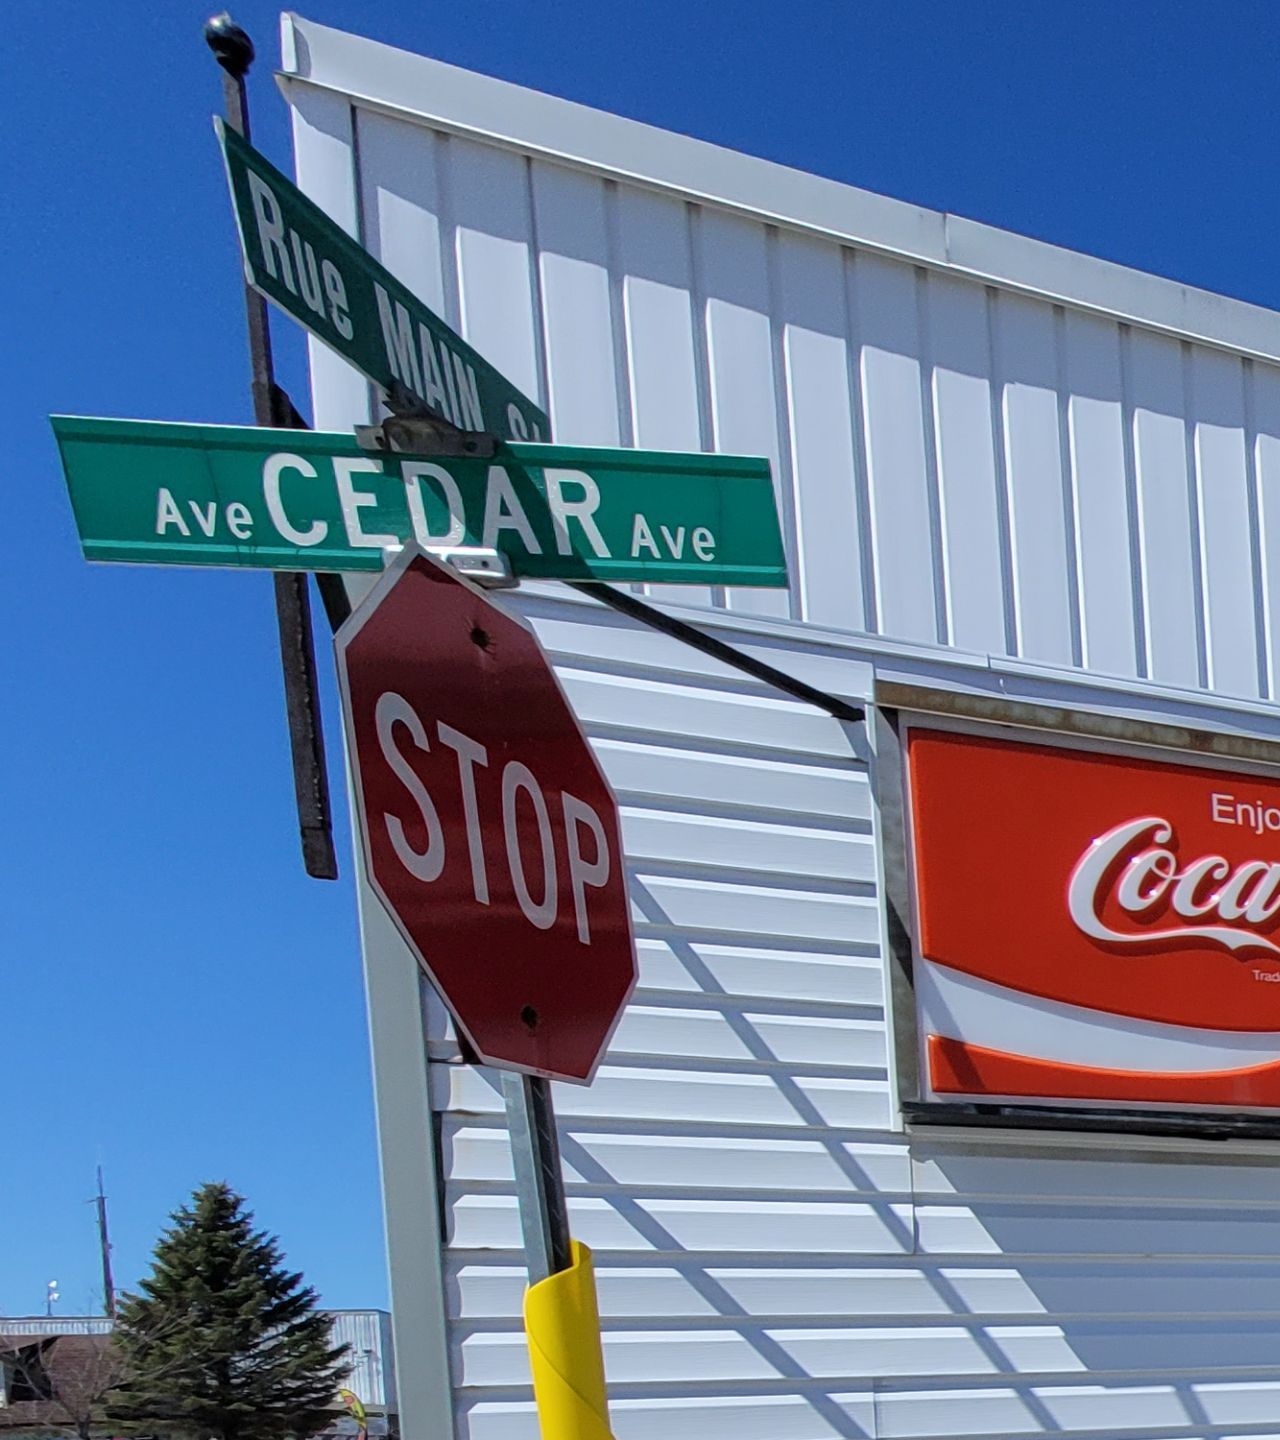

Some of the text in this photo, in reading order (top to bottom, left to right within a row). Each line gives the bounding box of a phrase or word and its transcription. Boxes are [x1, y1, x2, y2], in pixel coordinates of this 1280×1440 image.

[248, 168, 541, 442] Rue MAIN S
[156, 452, 717, 562] Ave CEDAR Ave
[374, 691, 610, 946] STOP
